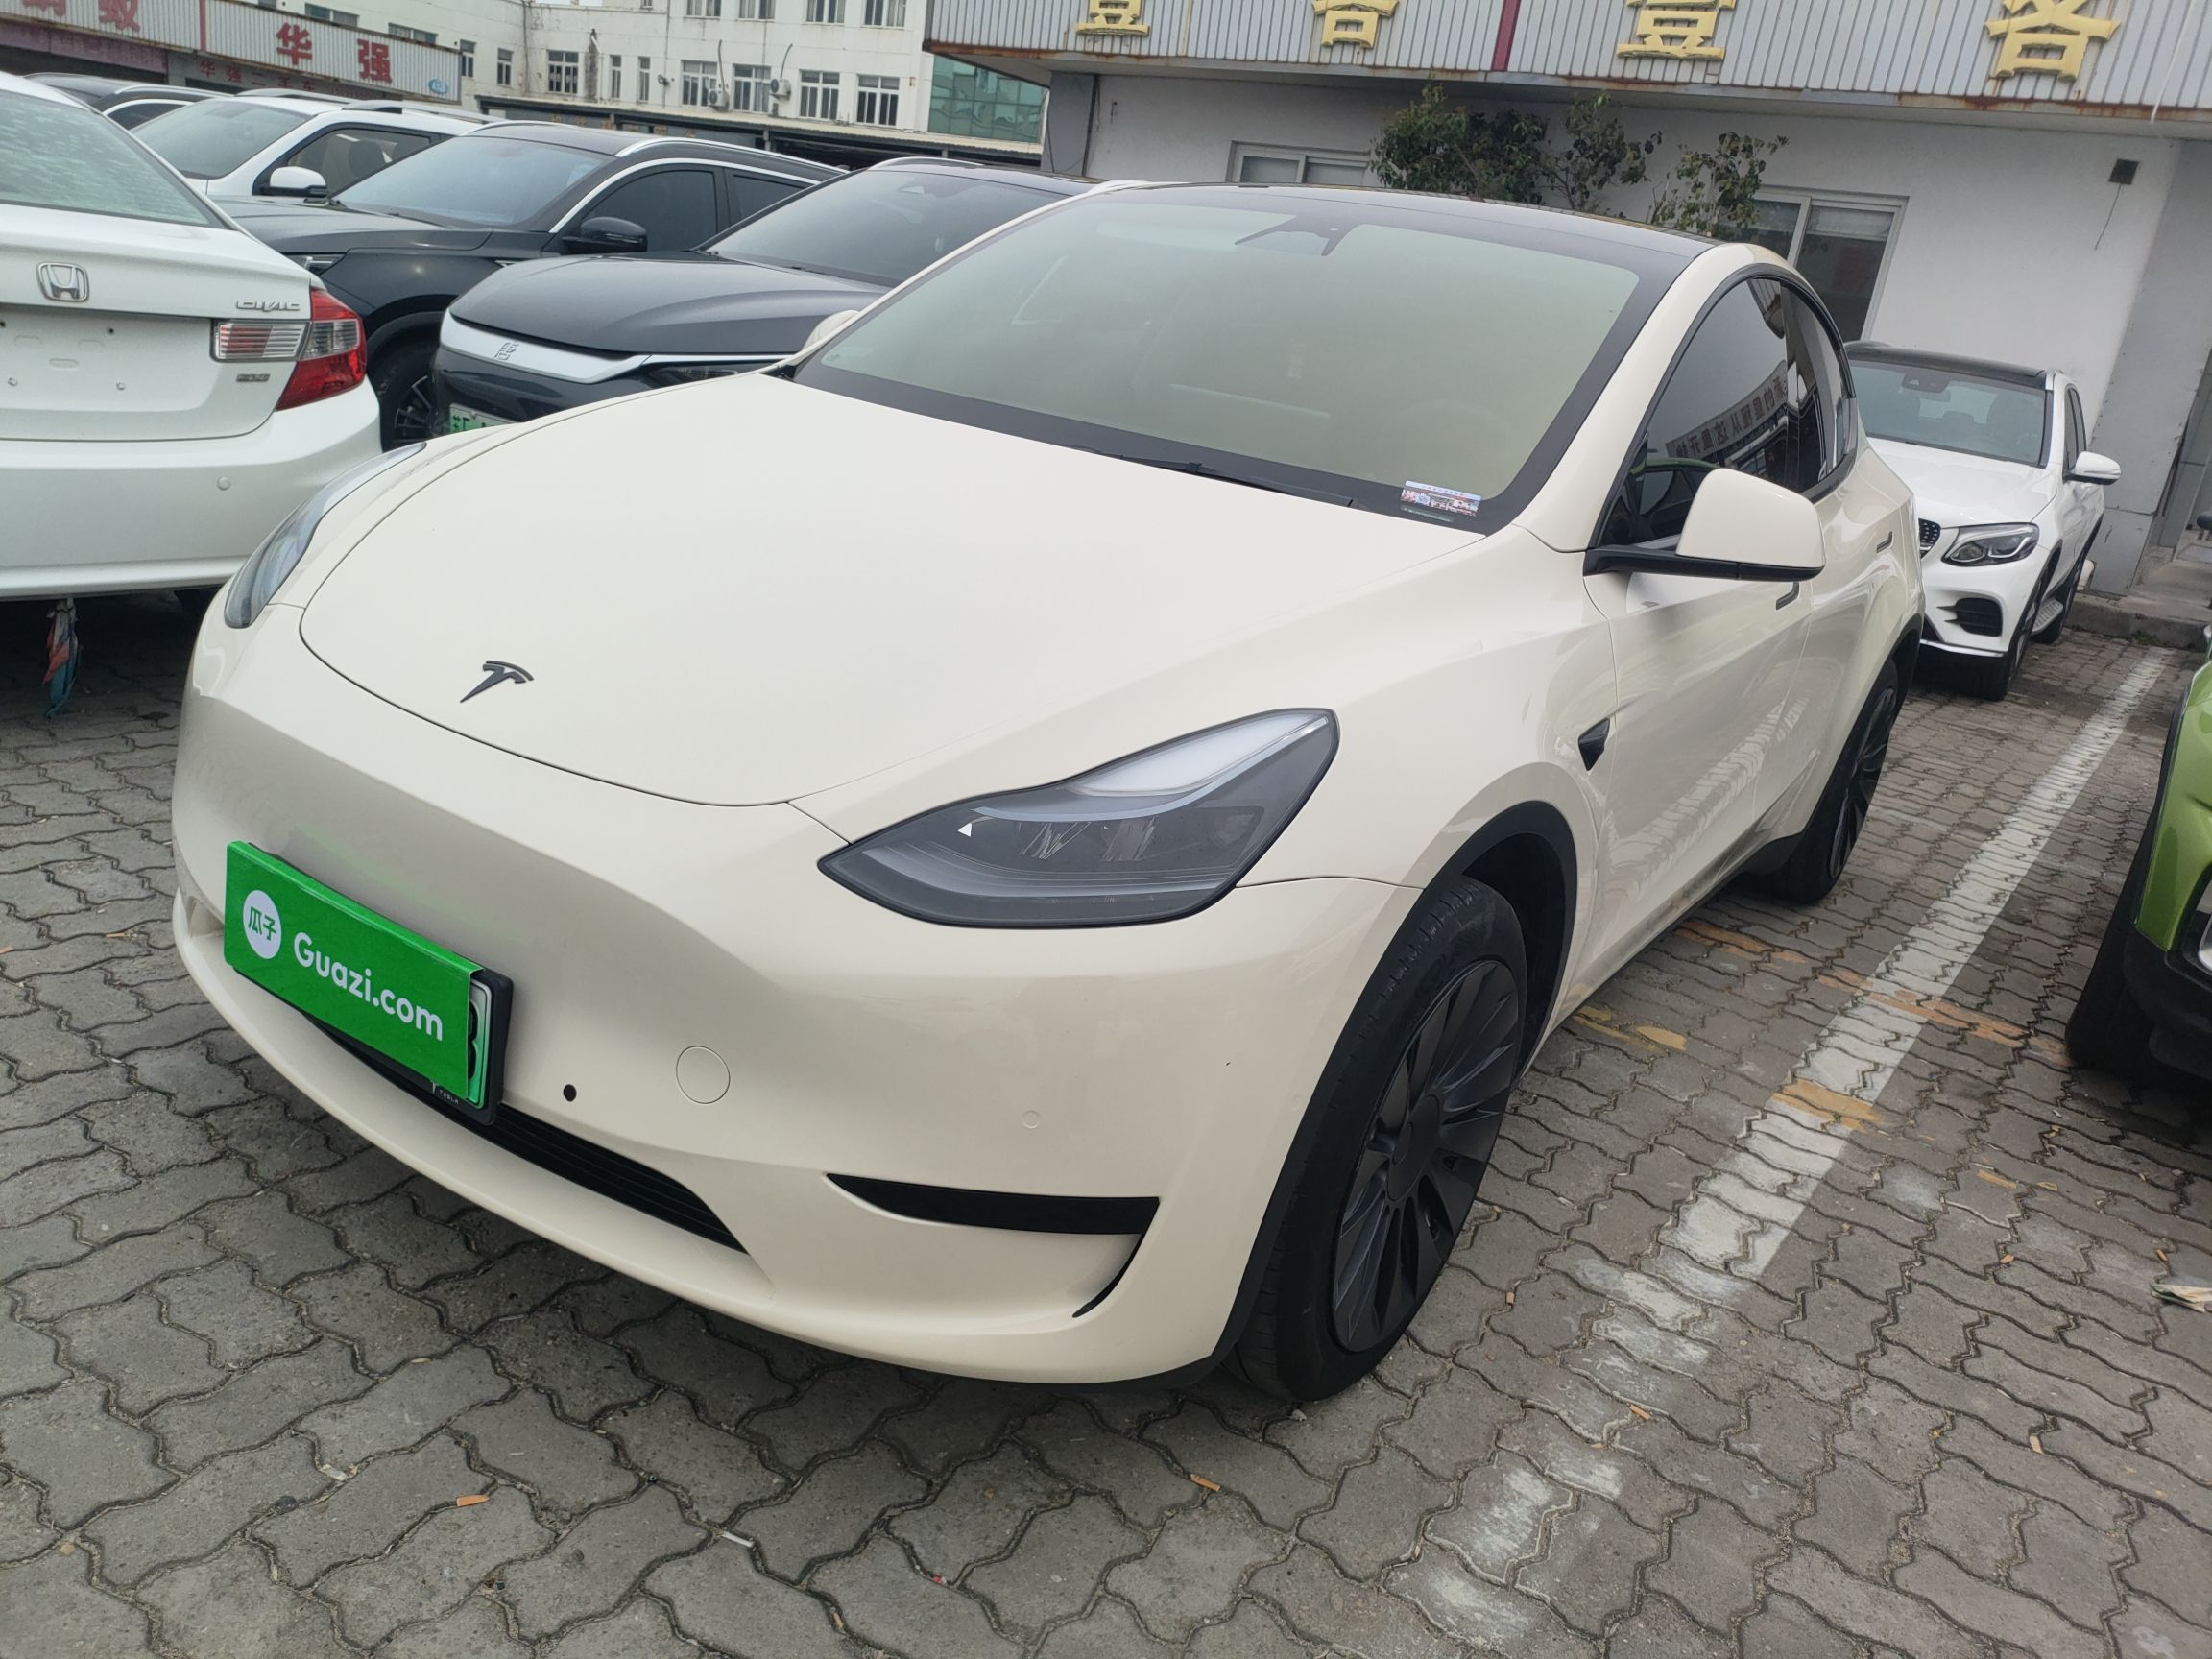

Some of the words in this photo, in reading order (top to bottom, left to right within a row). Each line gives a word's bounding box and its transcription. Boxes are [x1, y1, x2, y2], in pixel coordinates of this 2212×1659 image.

[276, 22, 392, 84] 华强
[235, 299, 301, 313] CIVIC
[248, 905, 277, 942] 瓜子
[293, 931, 443, 1042] Guazi.com
